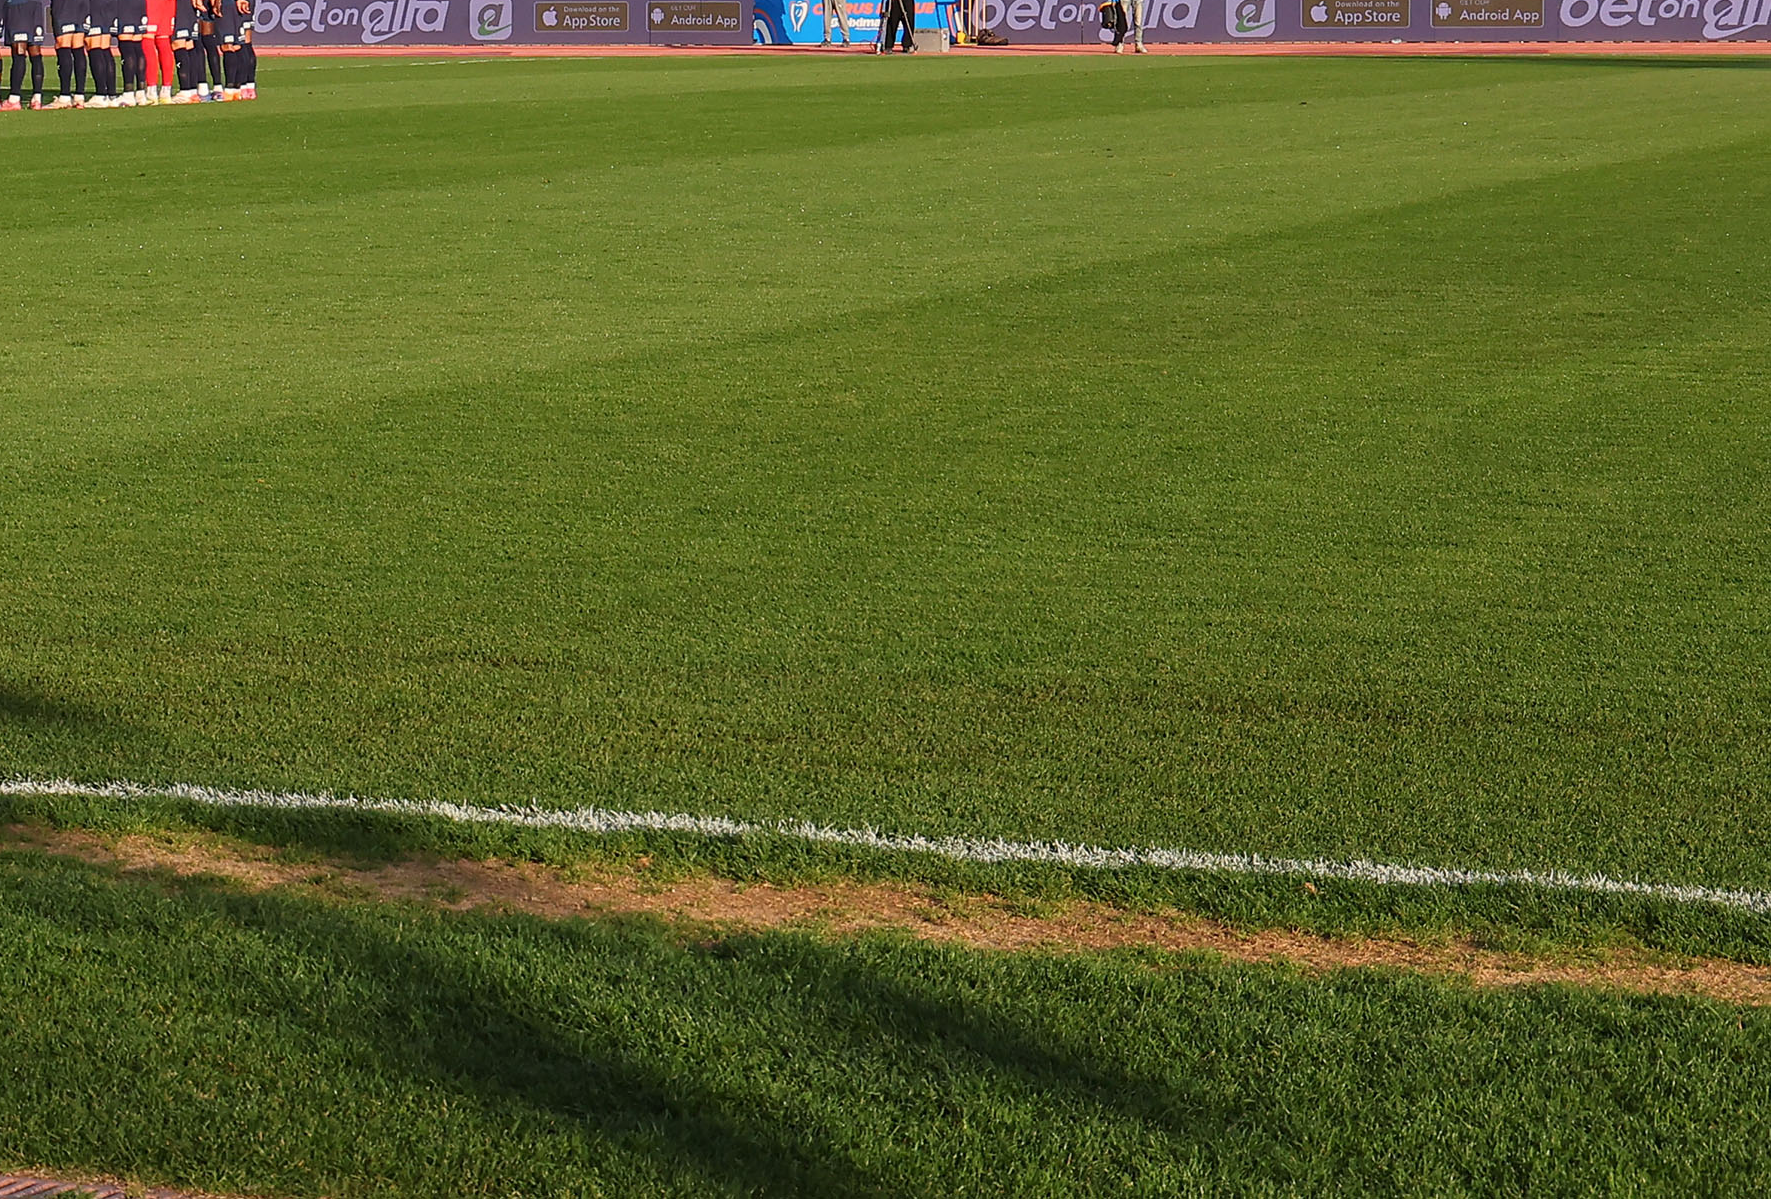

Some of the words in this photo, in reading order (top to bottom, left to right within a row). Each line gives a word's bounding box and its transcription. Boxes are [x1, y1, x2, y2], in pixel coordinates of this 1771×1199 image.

[327, 8, 358, 26] on
[1059, 2, 1096, 23] on
[1334, 10, 1363, 25] App
[1364, 9, 1400, 22] Store
[1460, 9, 1510, 21] Android
[1513, 10, 1539, 23] App
[1659, 0, 1700, 18] on
[563, 16, 589, 29] App
[590, 15, 621, 27] Store
[670, 14, 713, 26] Android
[716, 15, 738, 28] App
